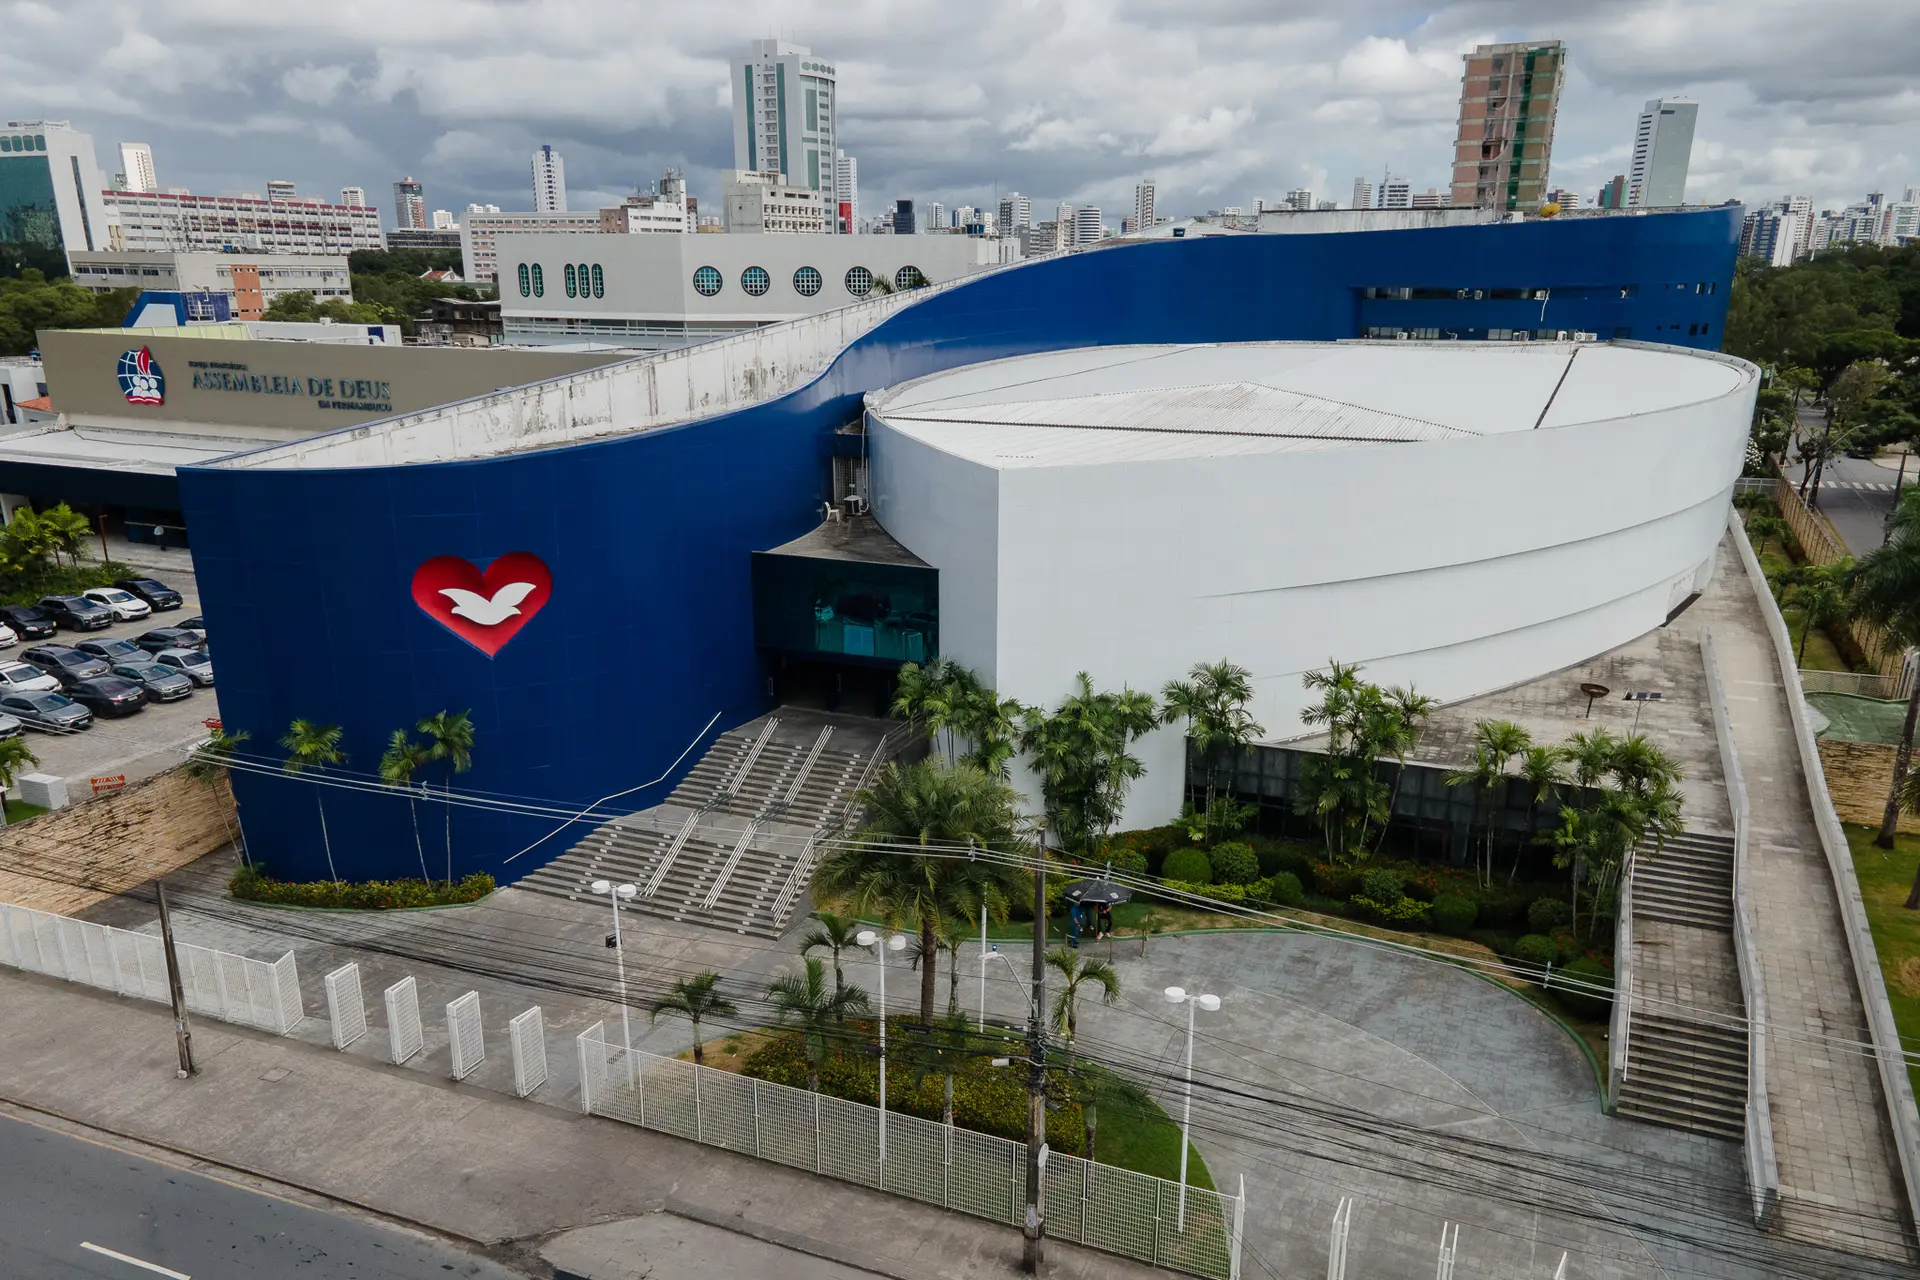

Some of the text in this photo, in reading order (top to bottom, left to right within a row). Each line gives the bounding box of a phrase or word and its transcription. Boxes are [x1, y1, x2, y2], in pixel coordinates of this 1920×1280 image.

[192, 372, 390, 400] ASSEMBLEIA DE DEUS
